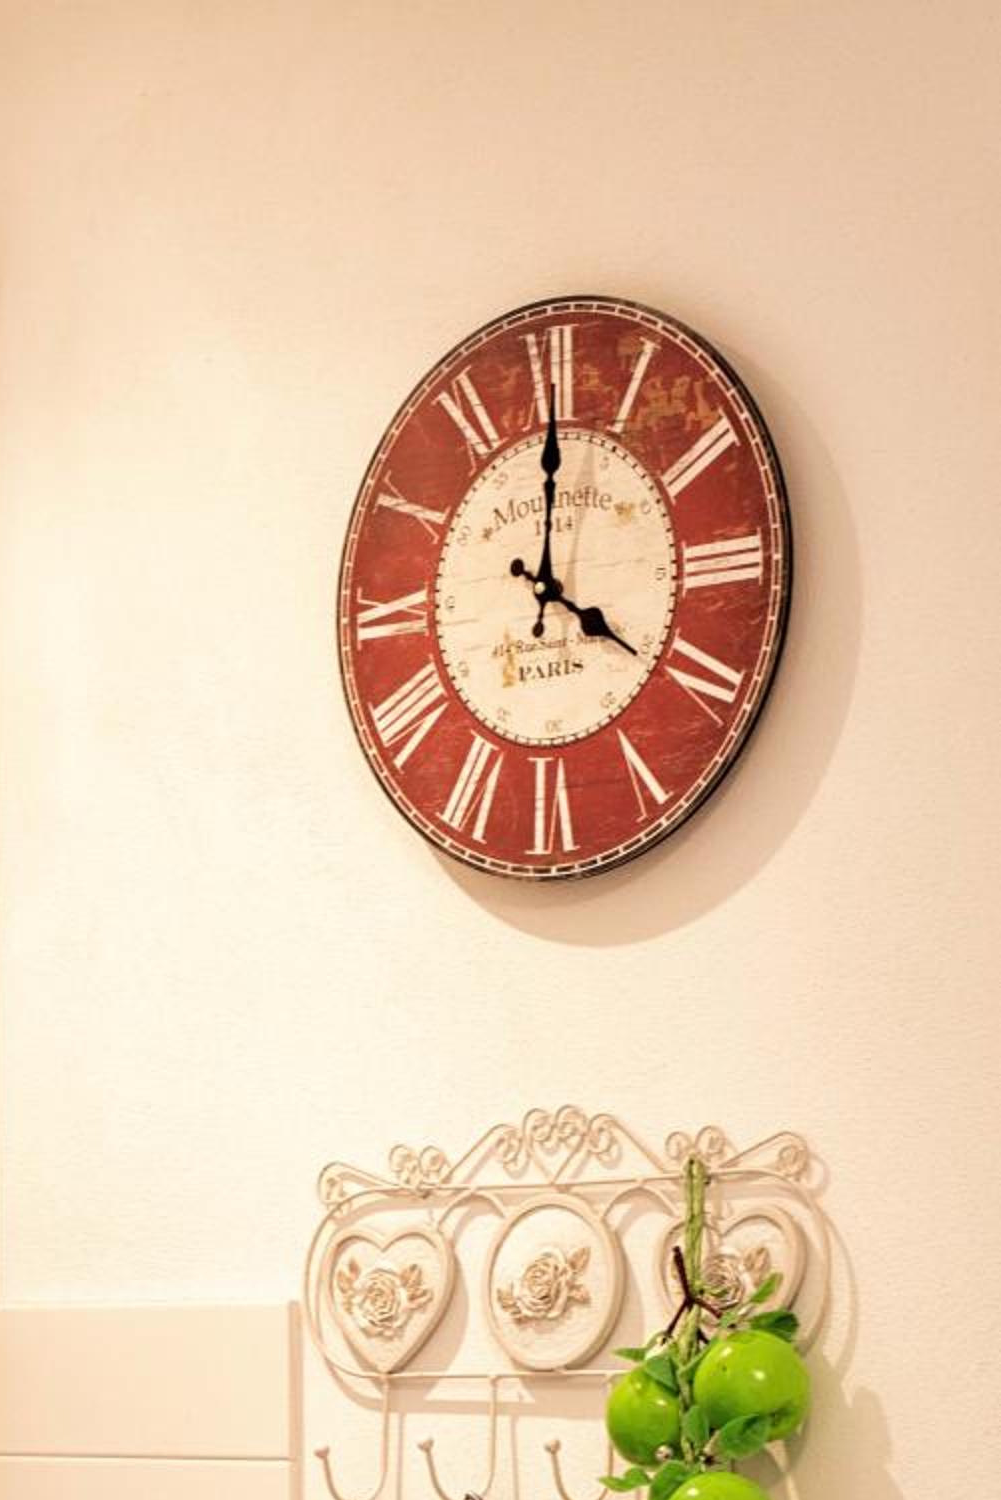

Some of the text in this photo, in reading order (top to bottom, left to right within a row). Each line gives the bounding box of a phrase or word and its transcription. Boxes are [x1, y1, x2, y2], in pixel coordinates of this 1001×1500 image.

[431, 364, 509, 478] XI
[605, 336, 661, 434] I
[658, 407, 740, 505] II
[372, 470, 451, 545] X
[492, 485, 612, 530] Mounette
[535, 515, 574, 536] 114
[680, 526, 763, 597] III
[357, 580, 429, 651] IX
[368, 654, 449, 776] VIII
[518, 657, 584, 682] PARIS
[663, 627, 746, 728] IV
[436, 730, 505, 843] VII
[525, 757, 580, 854] VI
[616, 728, 674, 823] V
